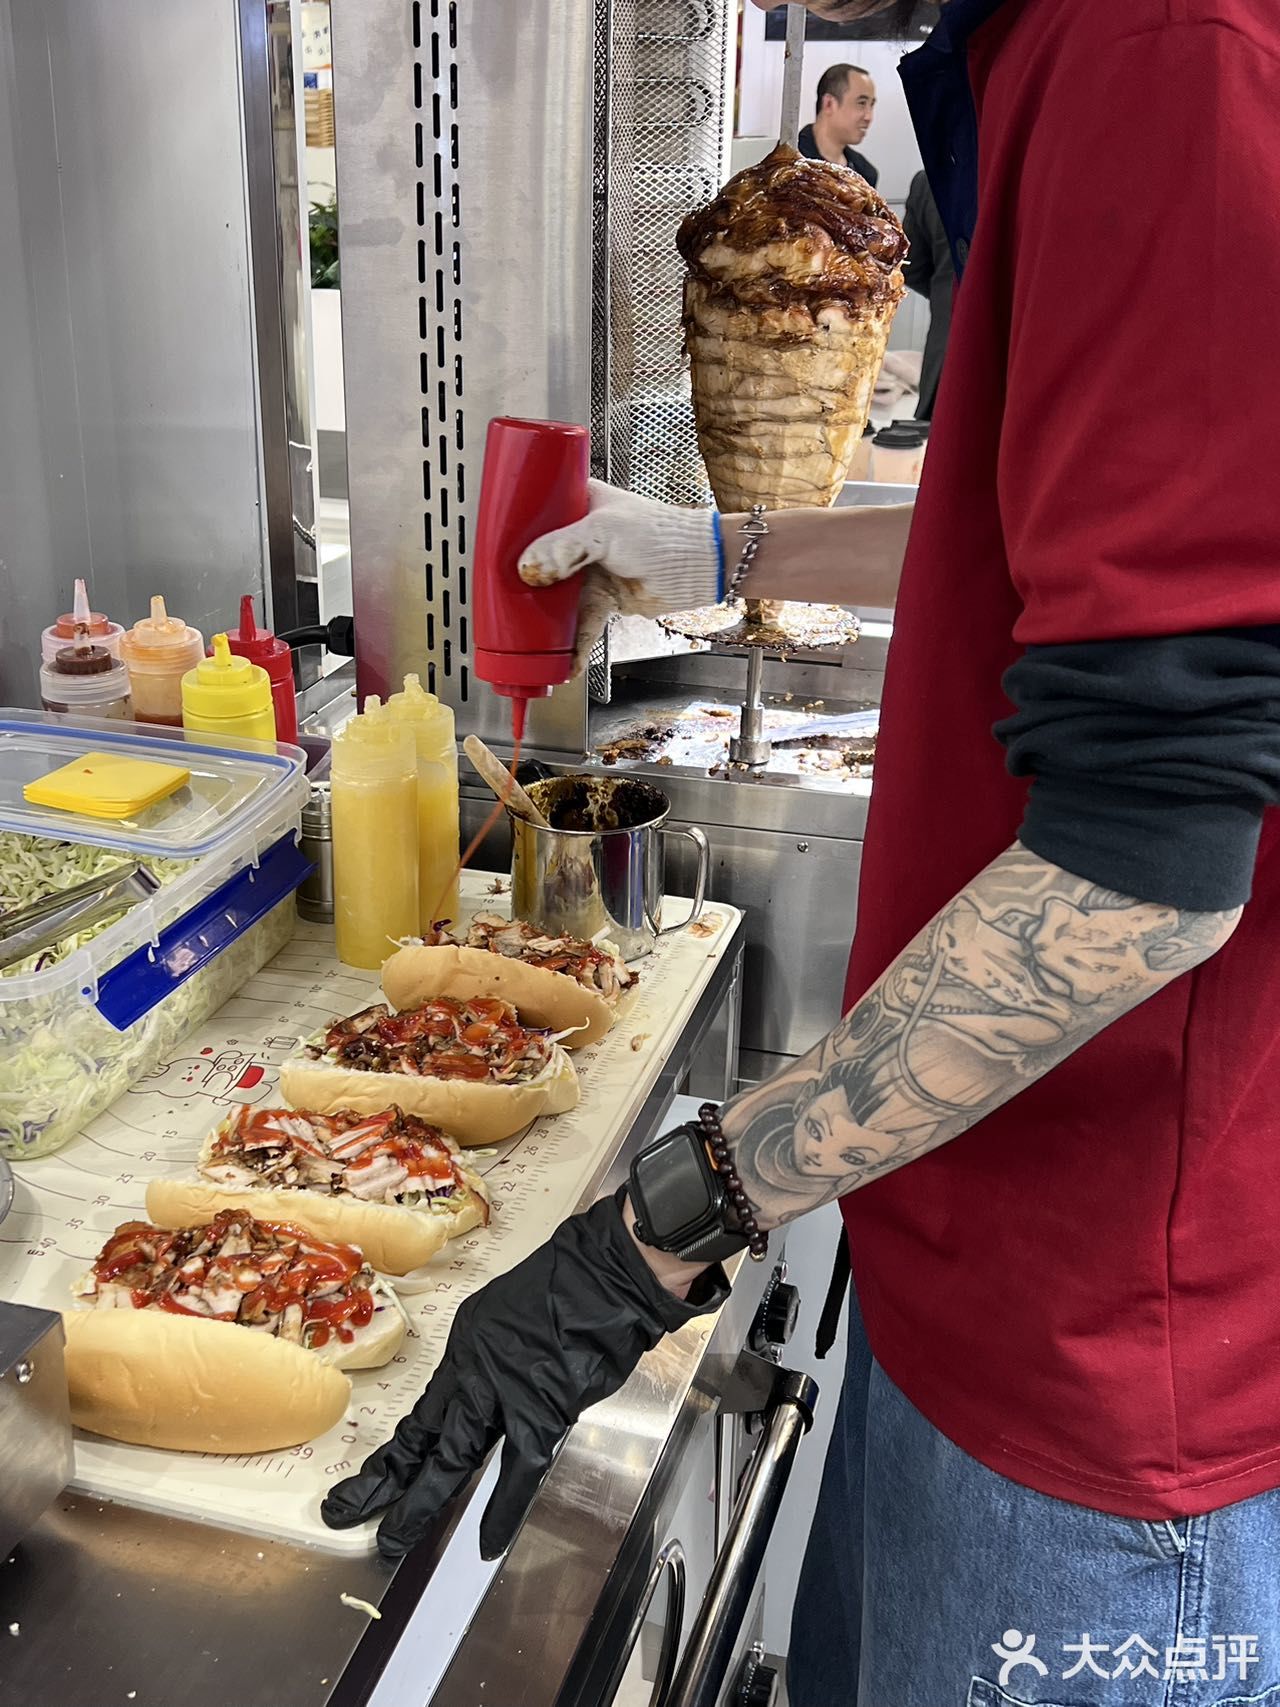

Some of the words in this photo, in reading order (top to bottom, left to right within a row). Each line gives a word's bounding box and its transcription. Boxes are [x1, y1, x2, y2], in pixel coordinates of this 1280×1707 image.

[324, 969, 338, 979] 12
[309, 984, 322, 993] 10
[162, 1130, 179, 1139] 15
[534, 1128, 549, 1139] 28
[139, 1151, 157, 1162] 20
[523, 1145, 539, 1157] 26
[512, 1163, 527, 1174] 24
[116, 1172, 134, 1184] 25
[500, 1181, 517, 1192] 22
[91, 1195, 111, 1207] 30
[490, 1200, 504, 1211] 20
[65, 1218, 85, 1230] 35
[40, 1237, 57, 1249] 40
[462, 1239, 479, 1251] 16
[27, 1249, 46, 1257] cm
[449, 1259, 466, 1271] 14
[435, 1282, 452, 1293] 12
[421, 1304, 438, 1316] 10
[406, 1329, 421, 1338] 8
[392, 1355, 407, 1364] 6
[377, 1381, 391, 1390] 4
[360, 1406, 376, 1415] 2
[341, 1435, 357, 1444] 0
[289, 1444, 314, 1460] 39
[324, 1460, 351, 1475] cm
